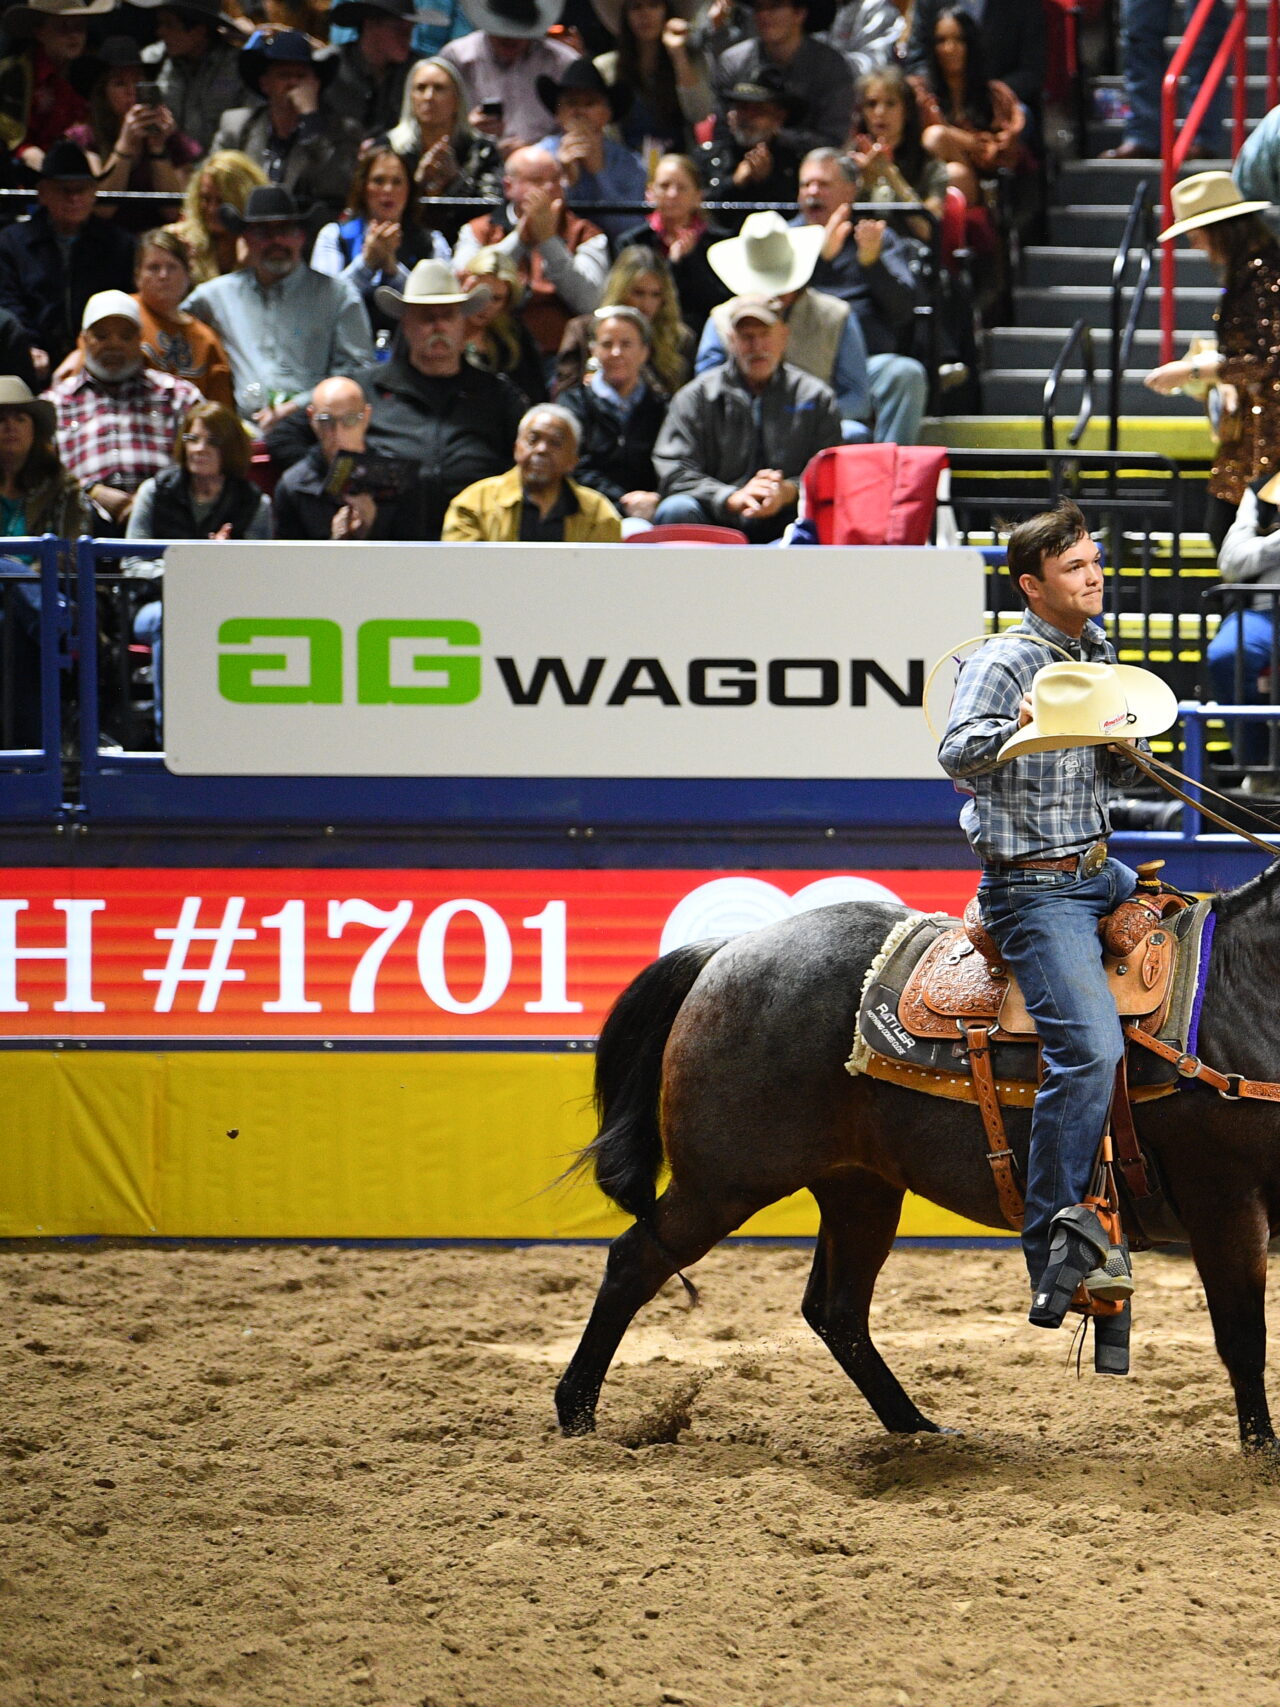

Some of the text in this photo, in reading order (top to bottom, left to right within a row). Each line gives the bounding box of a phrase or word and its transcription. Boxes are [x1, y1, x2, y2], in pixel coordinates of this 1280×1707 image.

[495, 657, 925, 708] WAGON
[142, 896, 585, 1014] #1701
[866, 1009, 885, 1031] NOTHING
[876, 1003, 916, 1049] RATTLER
